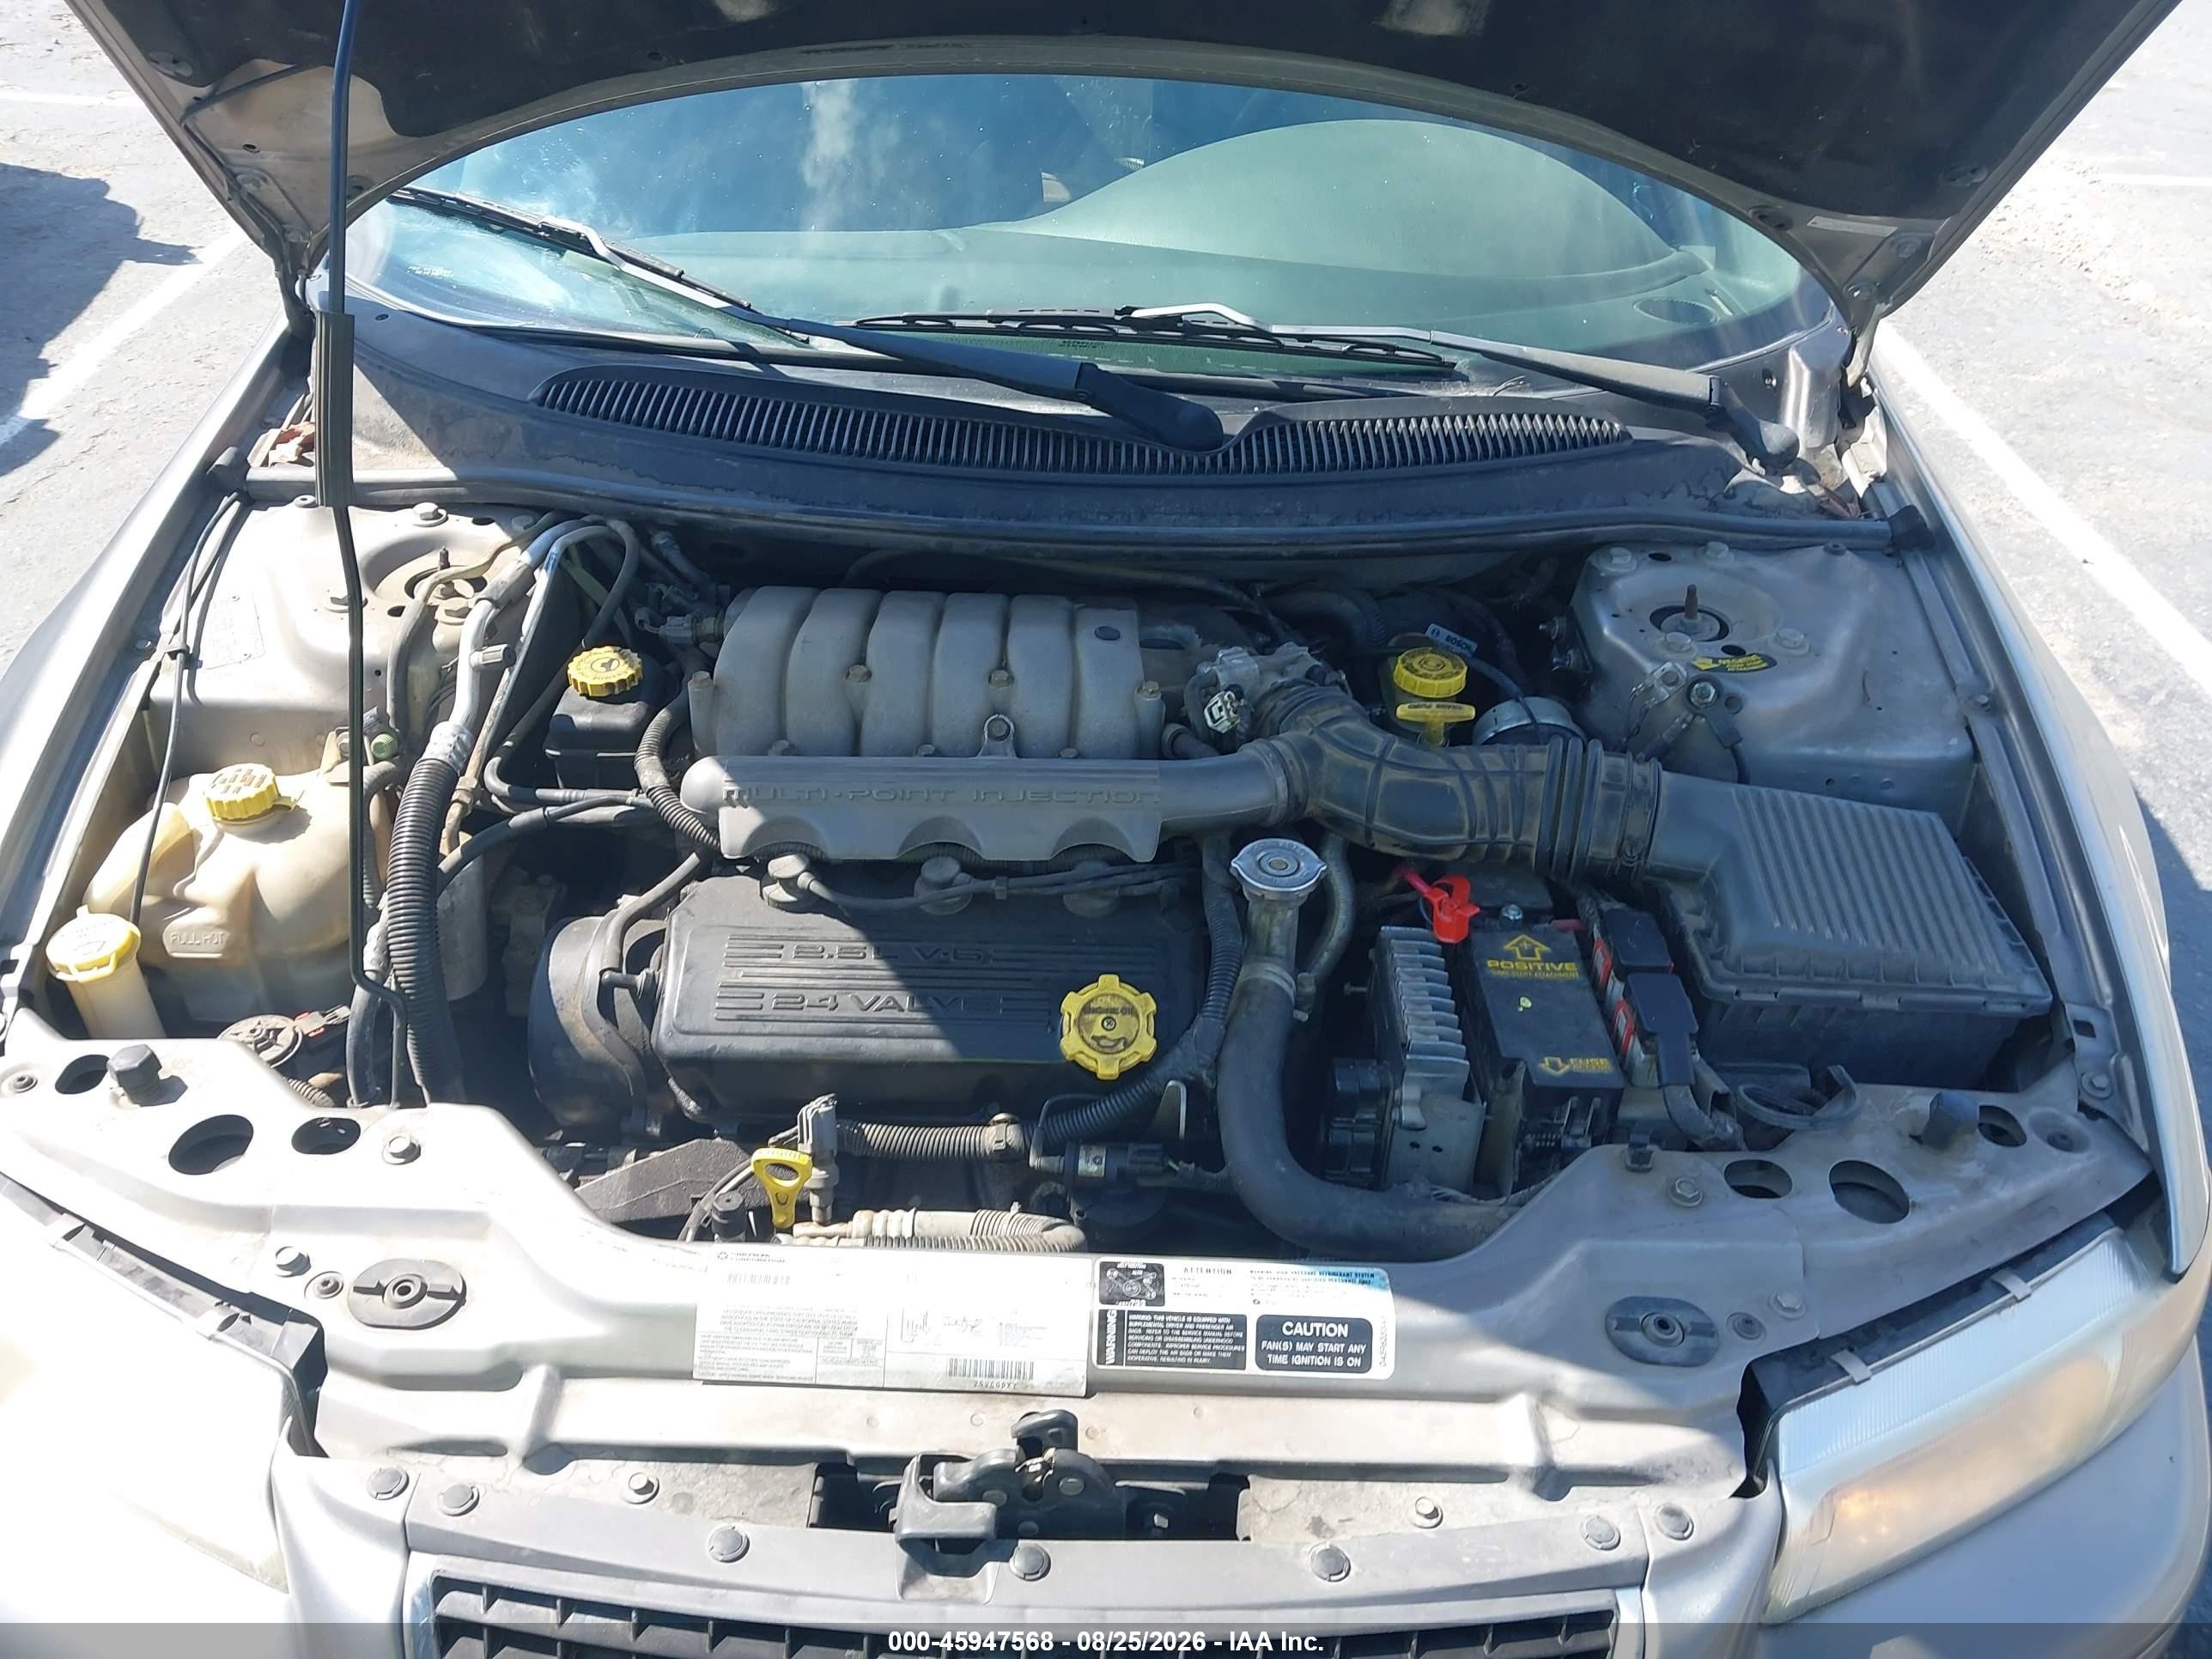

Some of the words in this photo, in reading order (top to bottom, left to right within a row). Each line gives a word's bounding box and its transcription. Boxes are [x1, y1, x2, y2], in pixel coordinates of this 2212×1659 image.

[972, 788, 1161, 804] INJECTION
[170, 931, 201, 945] FULL
[203, 931, 224, 945] HOT
[792, 945, 898, 961] 2.5L
[1487, 959, 1577, 971] POSITIVE
[771, 994, 840, 1012] 24
[1165, 1315, 1186, 1323] VEHICLE
[1193, 1316, 1218, 1324] EQUIPPED
[1105, 1310, 1117, 1364] WARNING
[1282, 1321, 1349, 1338] CAUTION
[1261, 1340, 1293, 1352] FAN(S)
[1295, 1341, 1315, 1353] MAY
[1317, 1342, 1346, 1354] START
[1347, 1344, 1367, 1355] ANY
[1267, 1354, 1289, 1365] TIME
[1291, 1355, 1331, 1367] IGNITION
[1334, 1357, 1344, 1367] IS
[1346, 1357, 1362, 1368] ON
